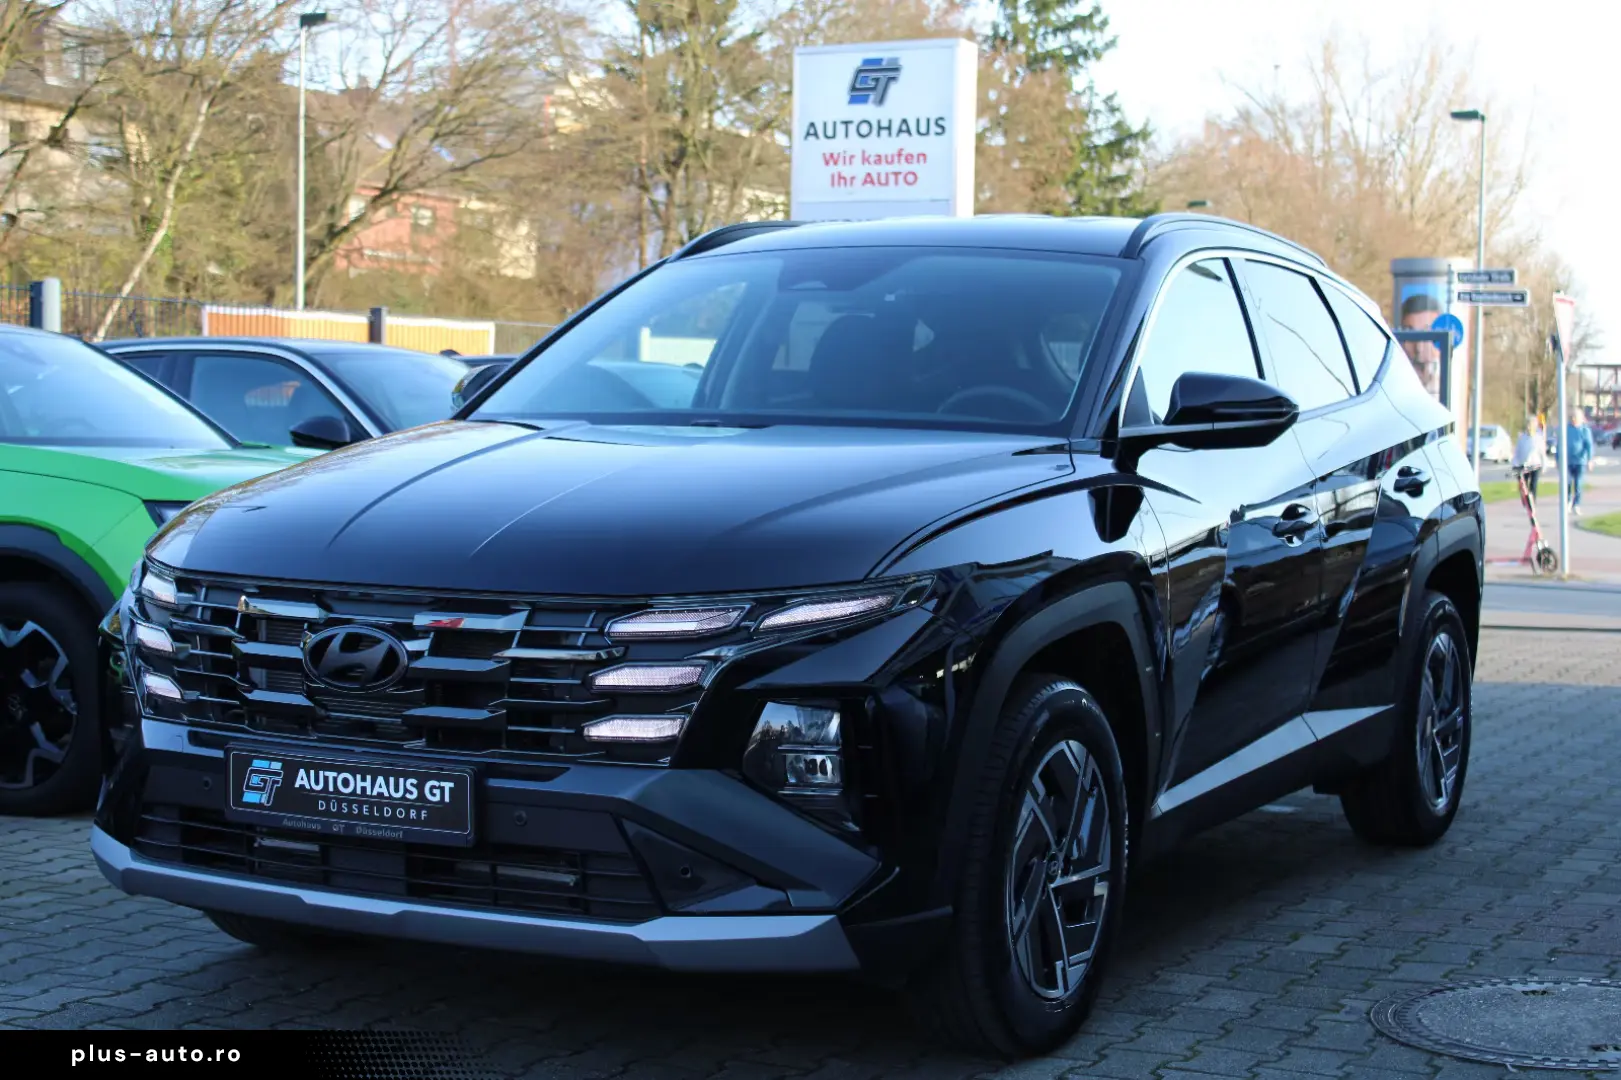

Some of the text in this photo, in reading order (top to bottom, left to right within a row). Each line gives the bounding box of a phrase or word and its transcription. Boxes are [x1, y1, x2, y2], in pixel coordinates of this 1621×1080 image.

[803, 117, 947, 141] AUTOHAUS
[822, 149, 927, 167] Wir kaufen
[830, 171, 919, 188] Ihr AUTO
[294, 768, 455, 803] AUTOHAUS GT
[318, 799, 429, 821] DÜSSELDORF
[282, 818, 403, 839] Autohaus GT Düsseldorf
